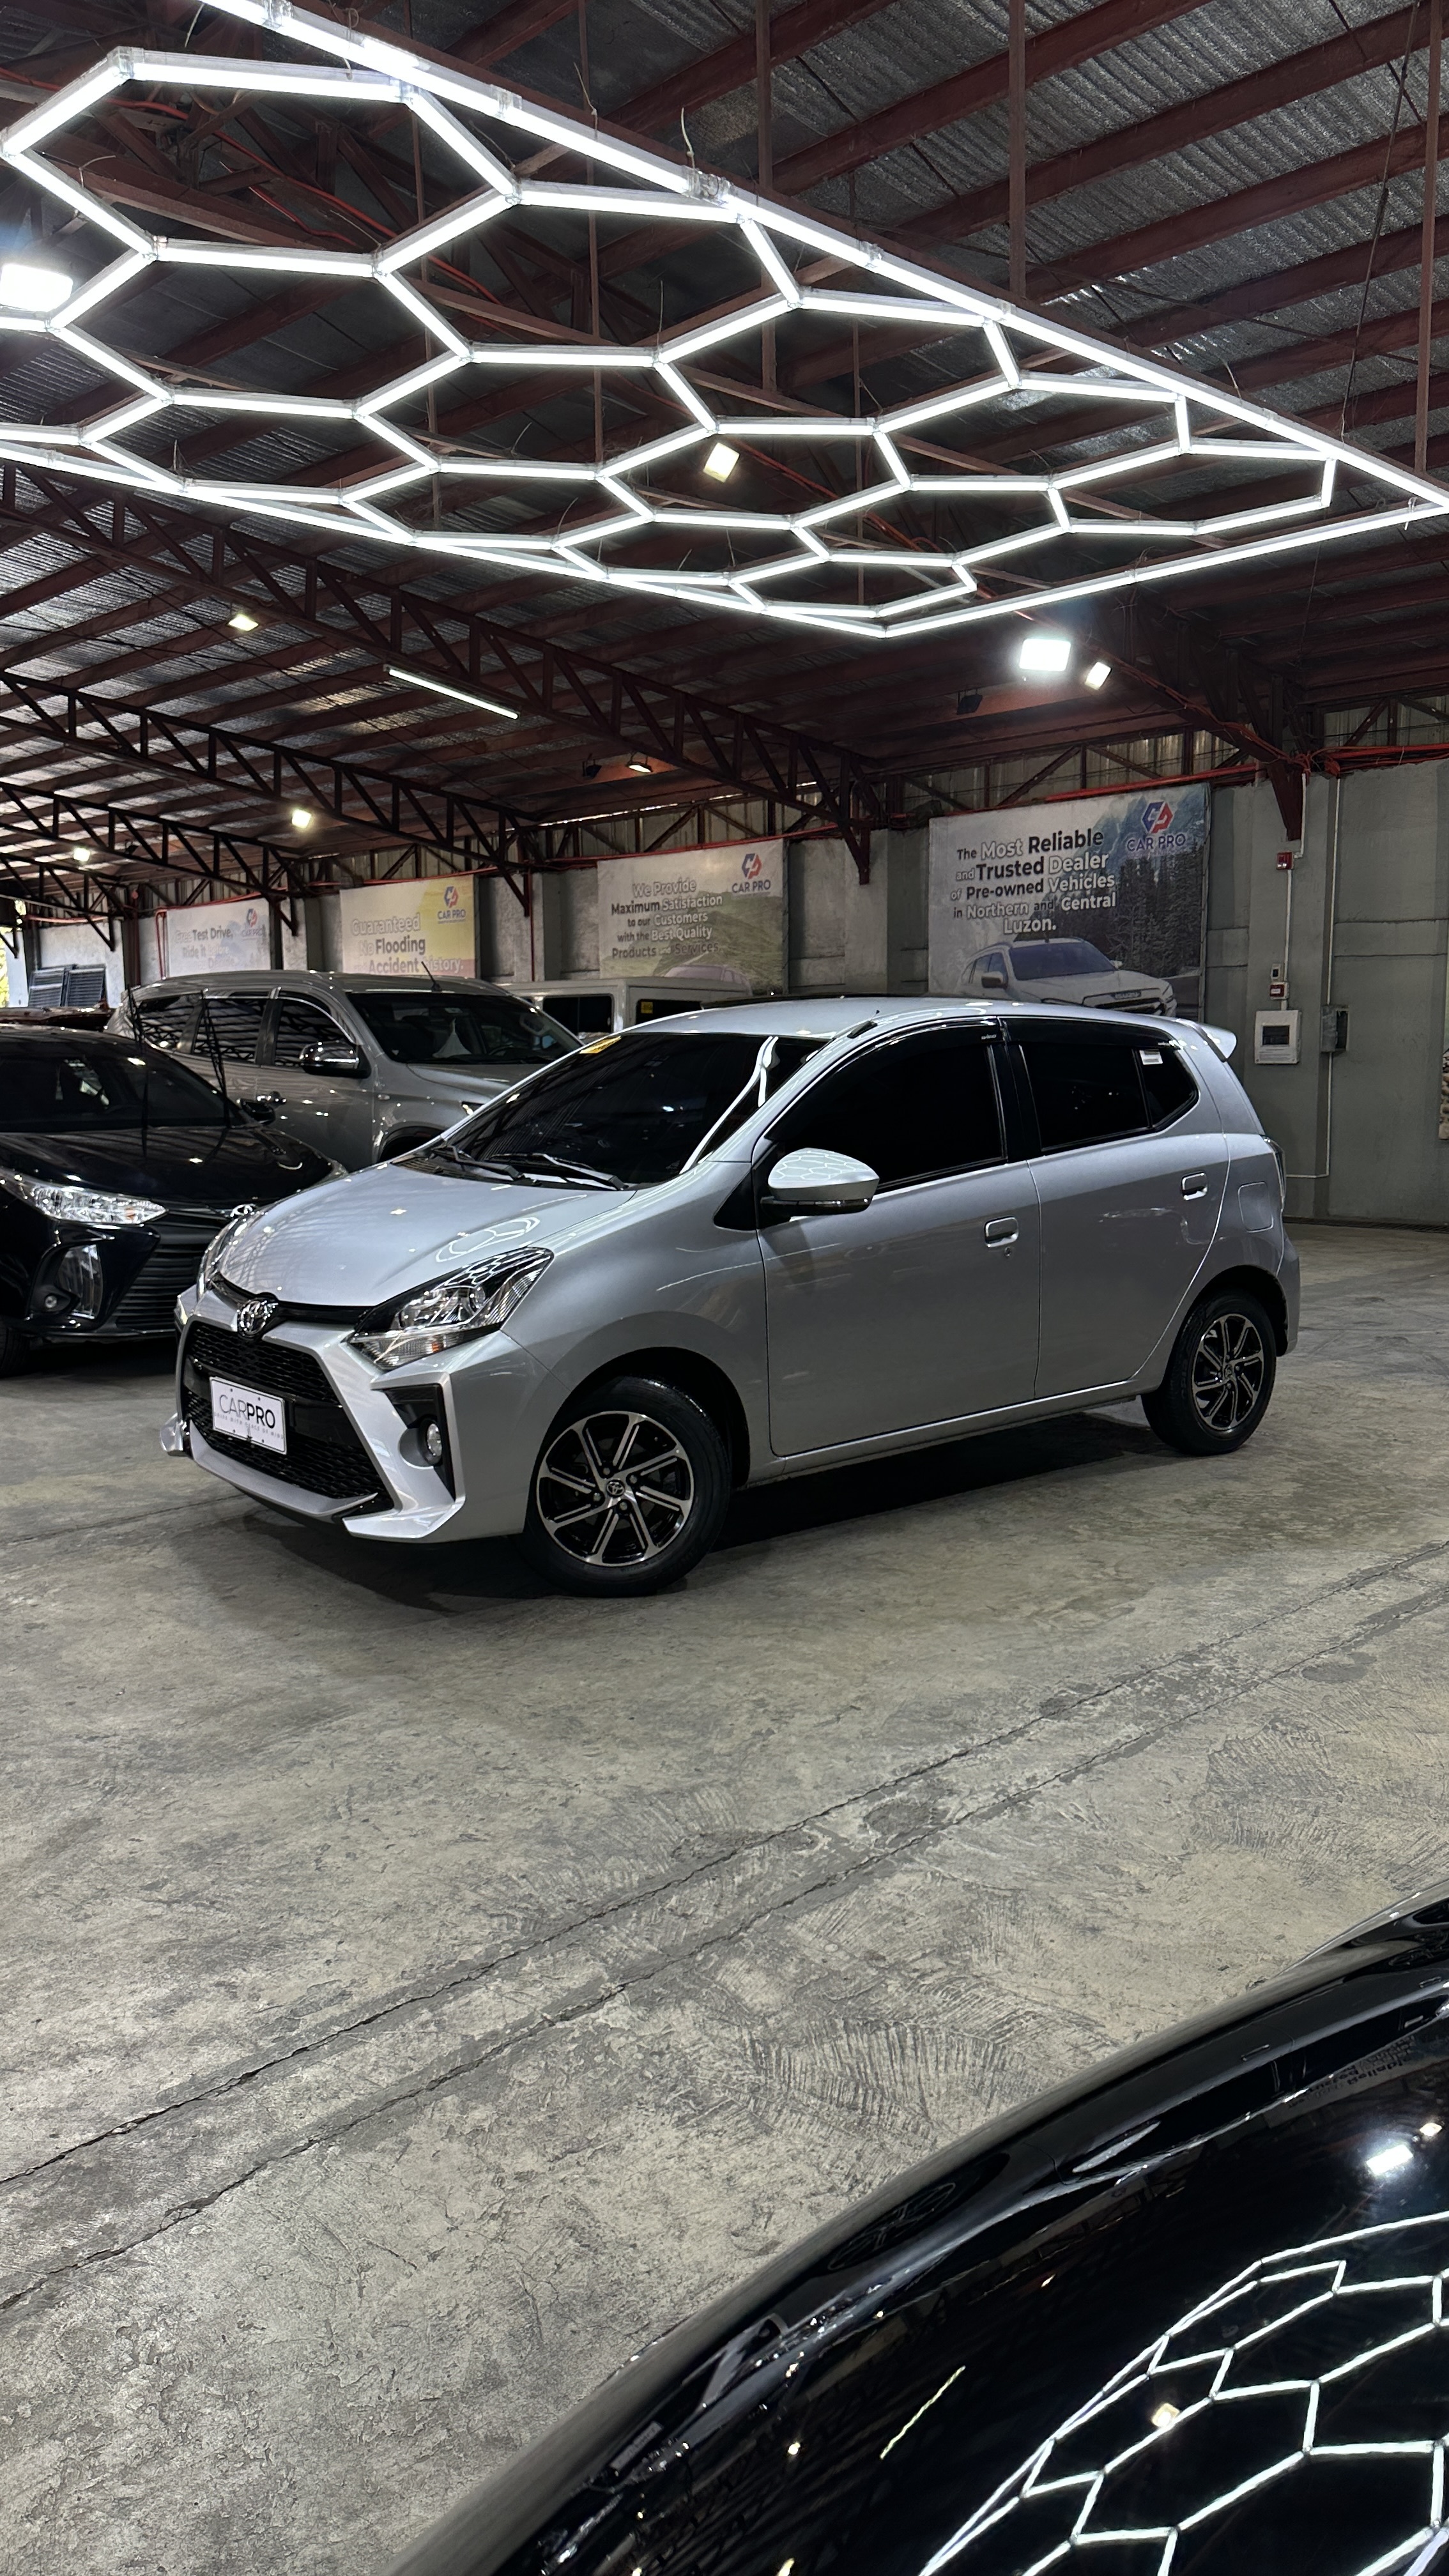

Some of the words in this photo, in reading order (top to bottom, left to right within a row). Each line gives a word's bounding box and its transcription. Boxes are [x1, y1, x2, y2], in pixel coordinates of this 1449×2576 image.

[957, 848, 977, 860] The
[981, 838, 1023, 861] Most
[1028, 829, 1104, 854] Reliable
[1126, 837, 1154, 852] CAR
[1158, 833, 1186, 849] PRO
[956, 868, 976, 882] and
[976, 855, 1045, 881] Trusted
[1048, 852, 1109, 875] Dealer
[632, 882, 652, 898] We
[653, 876, 697, 896] Provide
[732, 882, 750, 893] CAR
[752, 879, 771, 892] PRO
[950, 889, 962, 901] of
[966, 878, 1043, 900] Pre-owned
[1048, 872, 1116, 893] Vehicles
[437, 910, 451, 920] CAR
[452, 908, 466, 919] PRO
[611, 900, 660, 916] Maximum
[662, 894, 723, 911] Satisfaction
[953, 907, 963, 918] in
[966, 901, 1029, 919] Northern
[1034, 899, 1054, 911] and
[1061, 891, 1116, 911] Central
[351, 911, 421, 936] Guaranteed
[627, 918, 636, 927] to
[638, 917, 651, 926] our
[654, 912, 709, 926] Customers
[1003, 917, 1057, 935] Luzon.
[192, 928, 208, 941] Test
[210, 925, 233, 940] Drive,
[617, 931, 635, 942] with
[636, 931, 650, 940] the
[651, 926, 673, 941] Best
[676, 924, 712, 941] Quality
[182, 945, 199, 958] Ride
[376, 935, 425, 955] Flooding
[611, 946, 657, 958] Products
[369, 956, 420, 973] Accident
